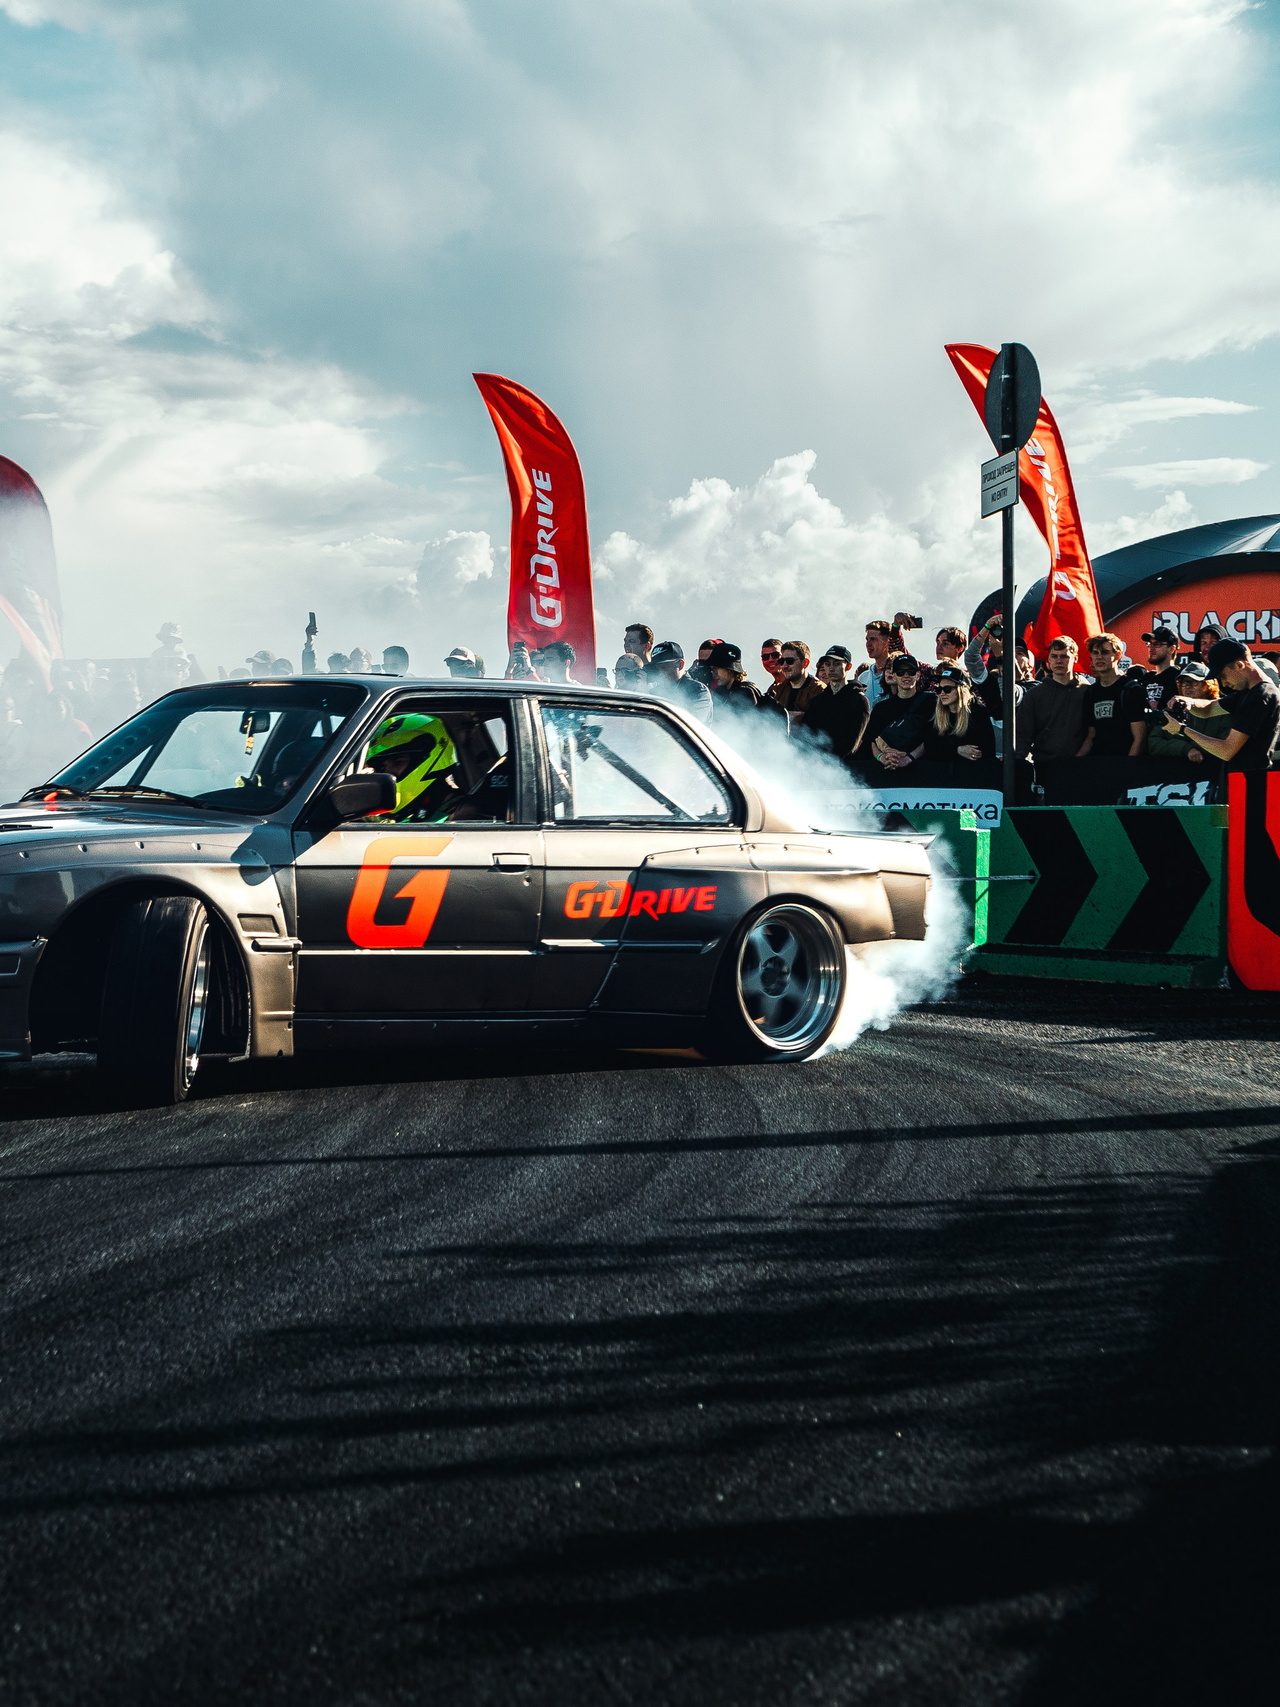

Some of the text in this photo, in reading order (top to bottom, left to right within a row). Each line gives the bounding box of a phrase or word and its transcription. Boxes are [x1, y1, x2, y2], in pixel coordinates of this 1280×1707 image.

[529, 468, 563, 628] G-DRIVE
[346, 836, 454, 949] G
[564, 879, 718, 921] G-DRIVE
